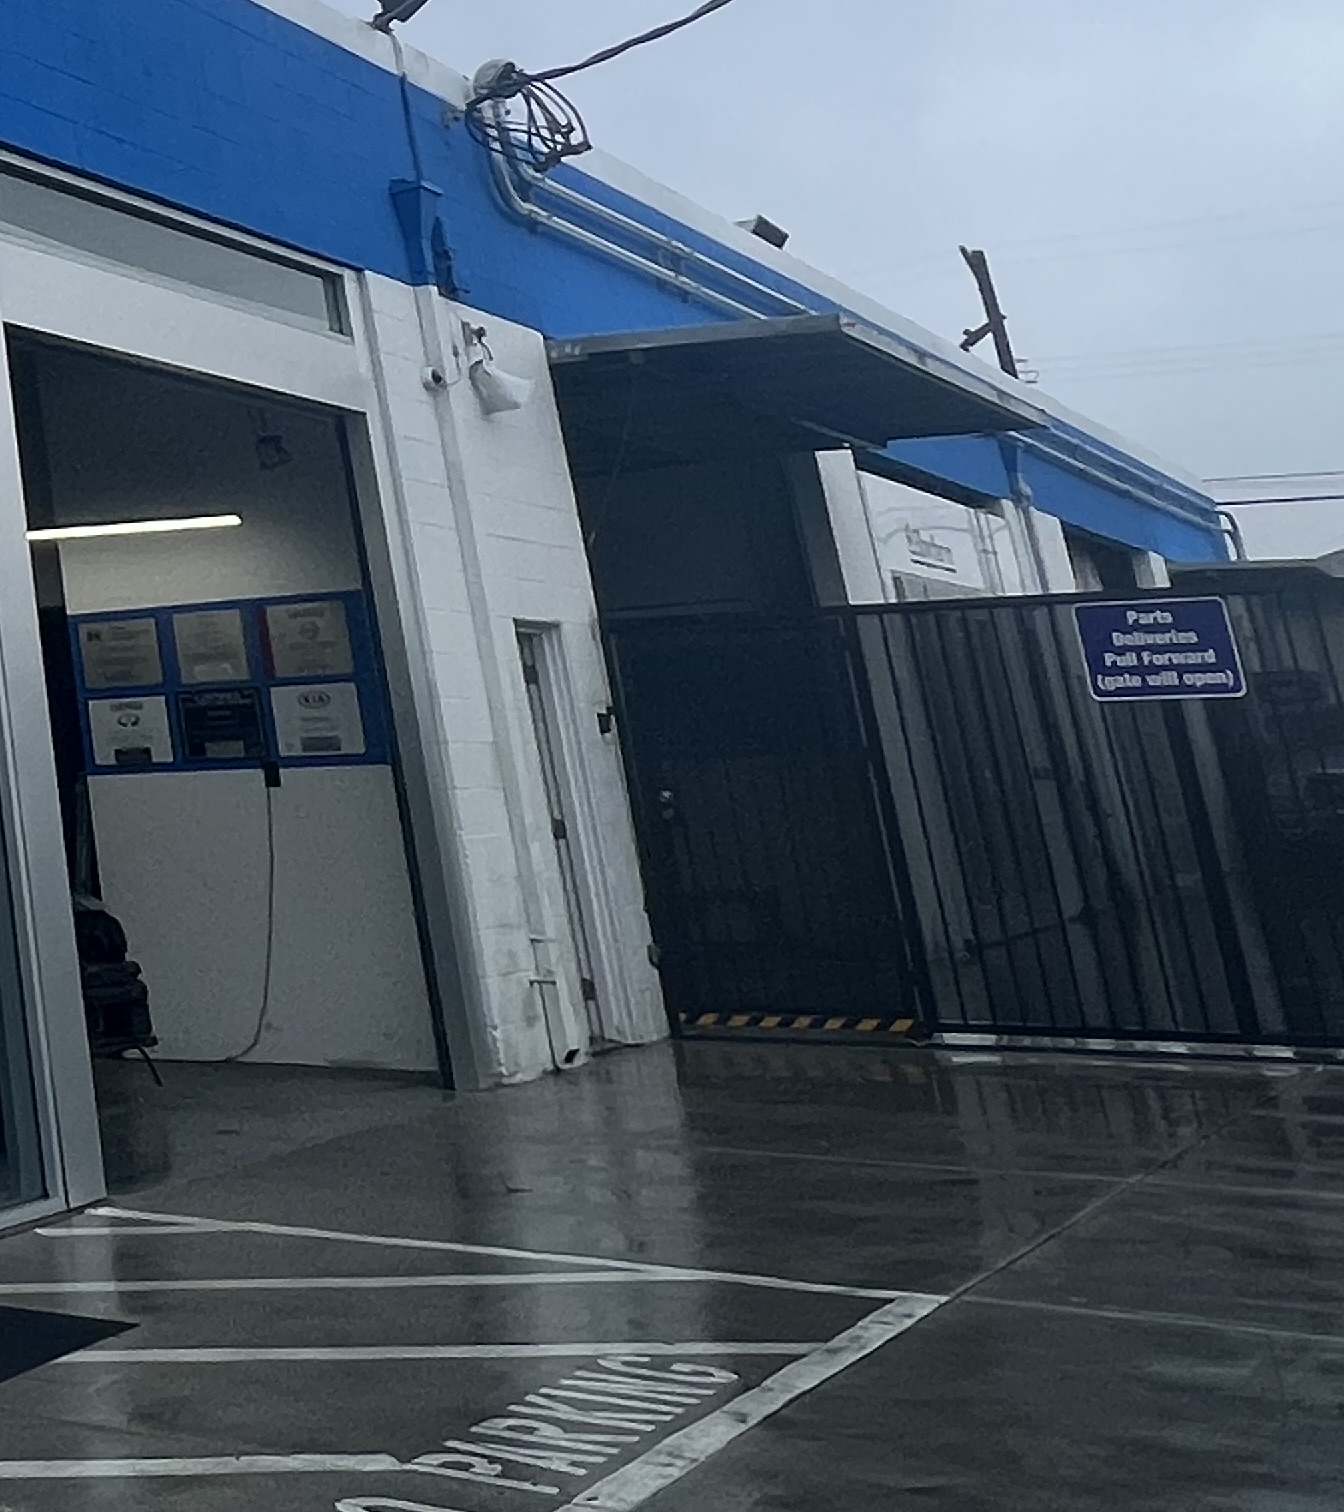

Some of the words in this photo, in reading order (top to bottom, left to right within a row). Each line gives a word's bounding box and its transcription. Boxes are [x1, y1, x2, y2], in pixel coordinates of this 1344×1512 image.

[1126, 610, 1174, 626] Parts
[1111, 630, 1199, 647] Deliveries
[1102, 652, 1138, 667] Pull
[1144, 670, 1180, 686] will
[402, 1355, 740, 1495] PARKING
